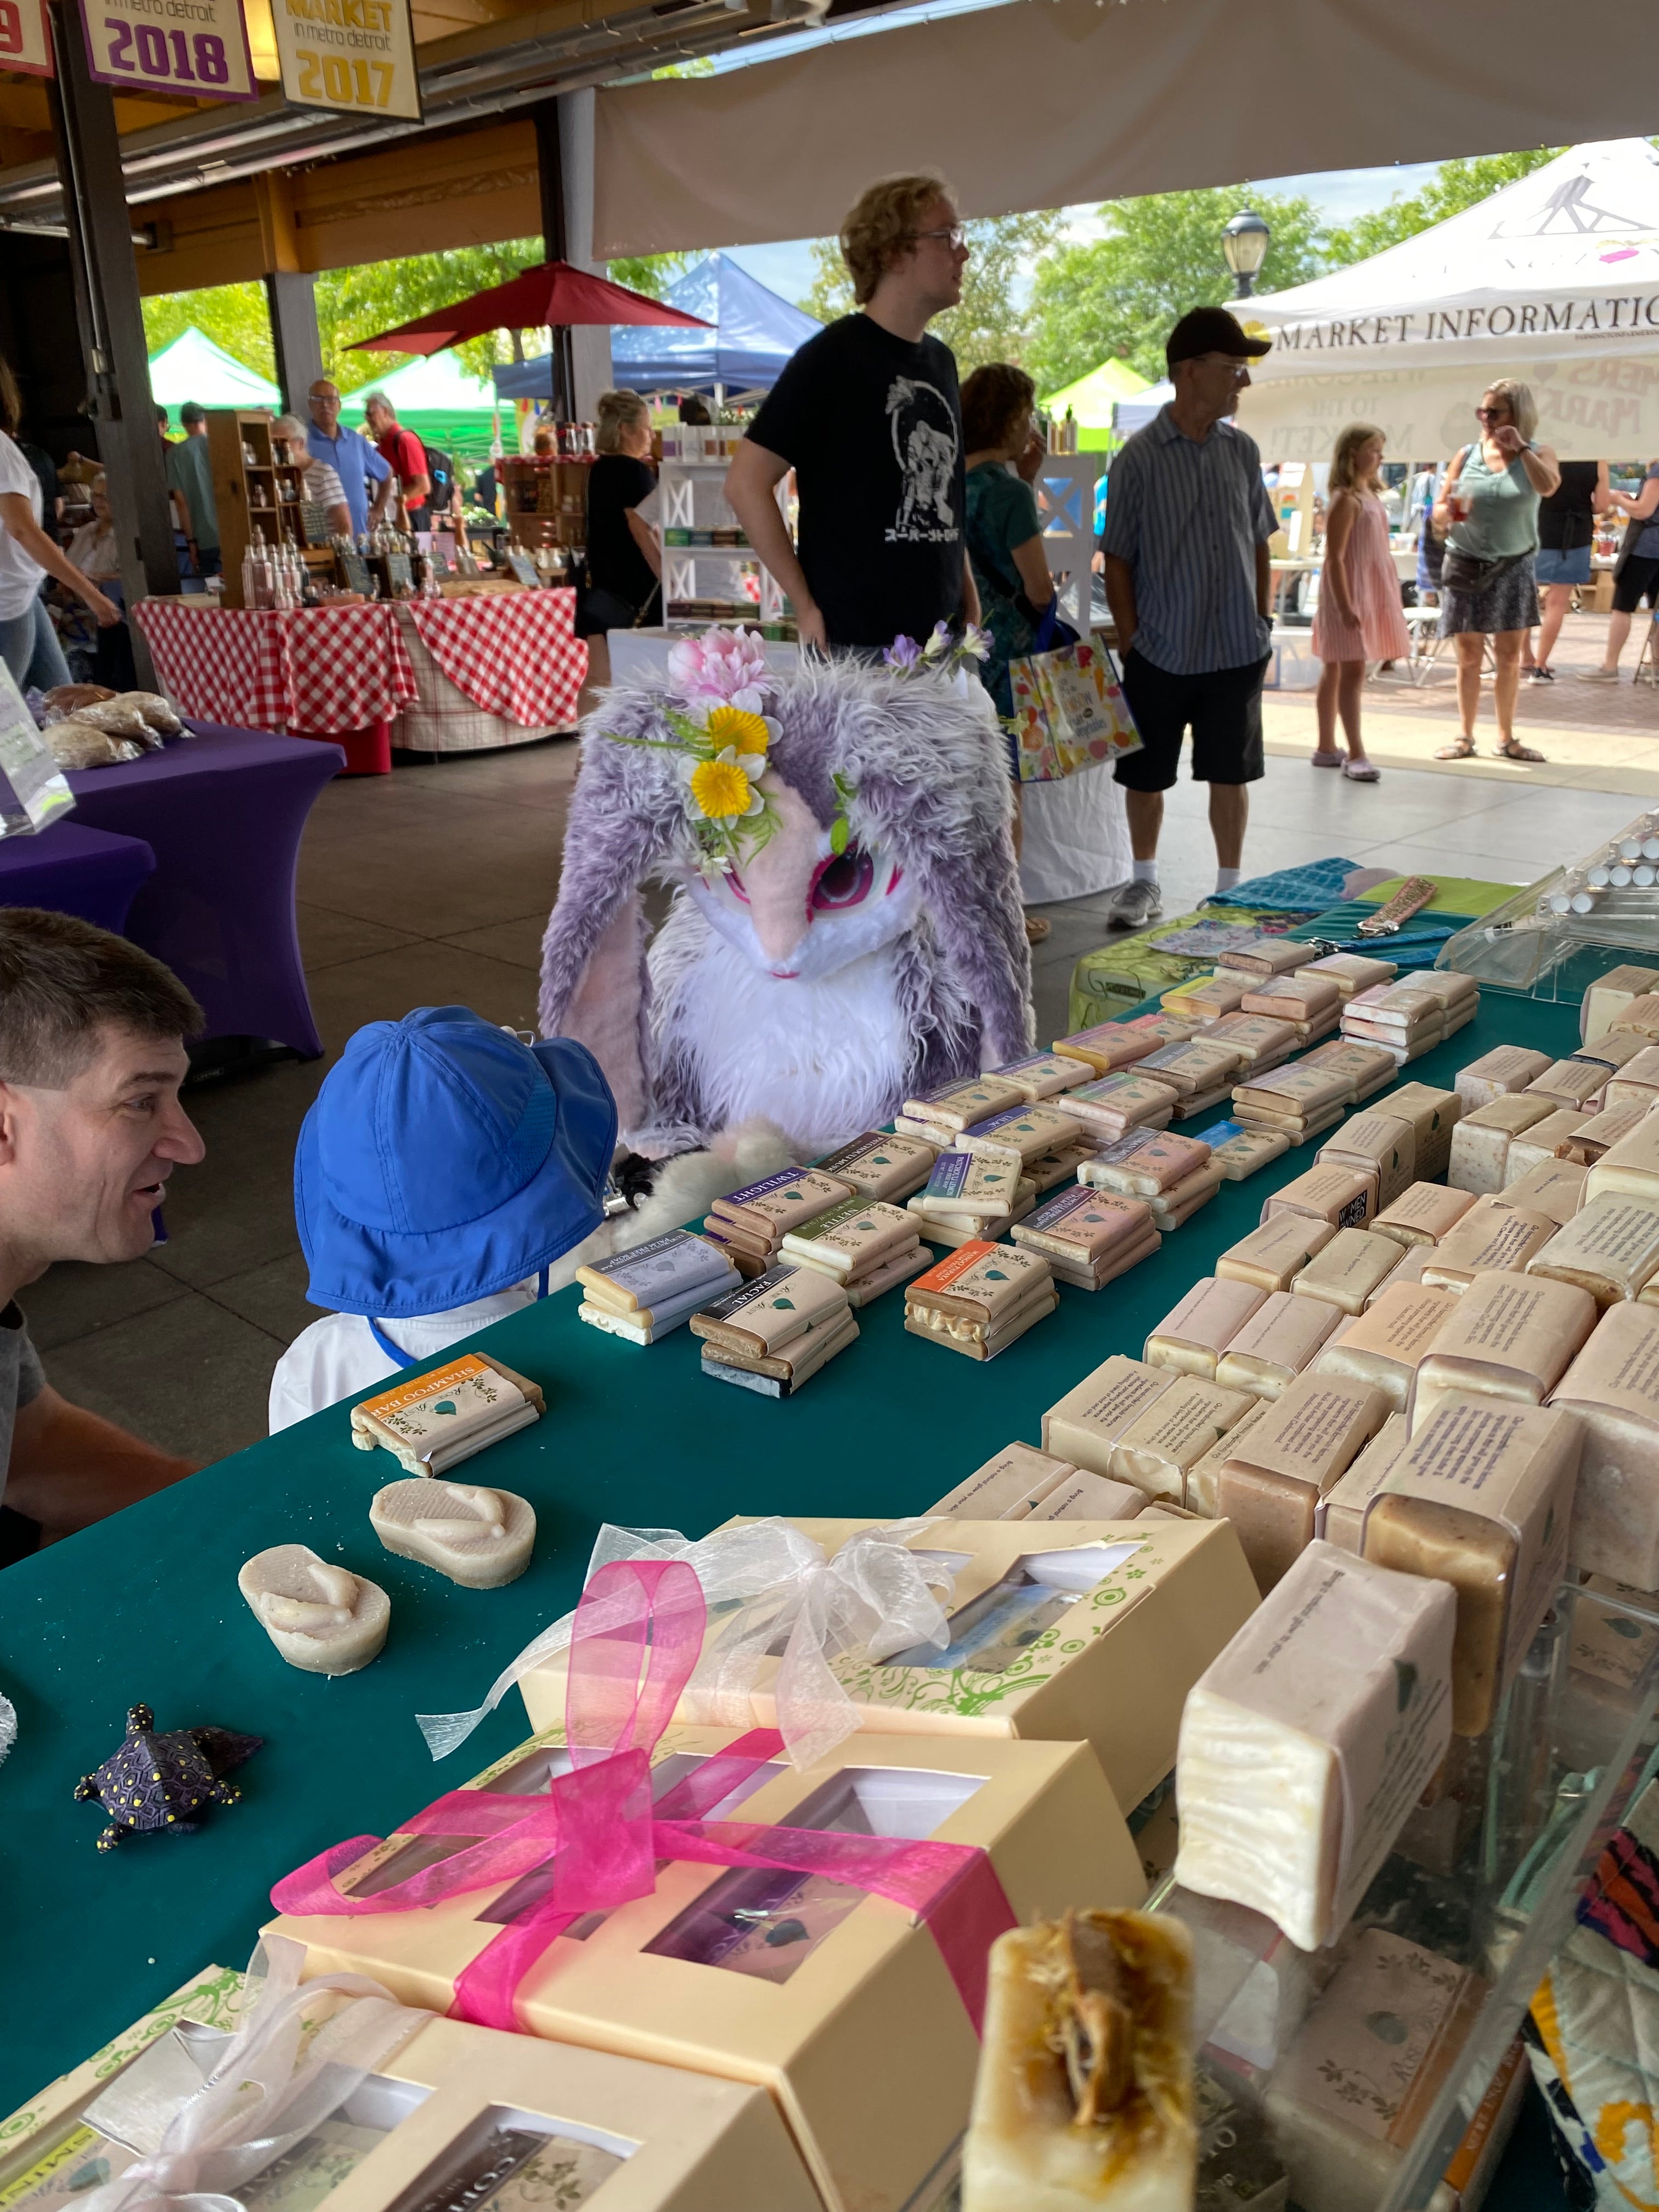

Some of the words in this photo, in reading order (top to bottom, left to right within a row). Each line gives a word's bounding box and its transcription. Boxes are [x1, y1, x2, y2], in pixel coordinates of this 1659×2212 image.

[166, 1, 216, 22] detroit
[285, 0, 392, 32] MARKET
[294, 22, 305, 38] in
[306, 25, 345, 46] metro
[347, 29, 392, 51] detroit
[104, 17, 229, 83] 2018
[296, 49, 394, 108] 2017
[1276, 314, 1414, 352] MARKET
[987, 1114, 1012, 1130] LILAC
[846, 1136, 884, 1159] PATCHOULI
[826, 1158, 849, 1172] MUSK
[951, 1156, 963, 1180] PATCHOULI
[731, 1171, 799, 1200] TWILIGHT
[946, 1181, 957, 1195] LEMON
[1058, 1187, 1089, 1210] PATCHOULI
[818, 1207, 858, 1228] NETTLE
[1033, 1208, 1062, 1228] BERGAMOT
[956, 1250, 979, 1266] MANGO
[938, 1265, 961, 1281] PAPAYA
[730, 1280, 773, 1305] FACIAL
[769, 1283, 799, 1300] ROSE
[744, 1299, 774, 1315] BEST
[404, 1366, 475, 1401] SHAMPOO
[438, 1384, 473, 1401] ROSE
[1131, 1387, 1152, 1404] handcrafted
[371, 1399, 401, 1417] BAR
[403, 1399, 440, 1417] BEST
[1118, 1403, 1134, 1416] formula
[1212, 1402, 1222, 1410] Our
[1353, 1401, 1364, 1409] Our
[1104, 1414, 1122, 1427] features
[1195, 1409, 1216, 1427] handcrafted
[1183, 1427, 1199, 1441] formula
[1170, 1440, 1187, 1453] features
[1211, 1449, 1221, 1460] Our
[998, 1459, 1013, 1471] Bring
[981, 1472, 998, 1485] natural
[970, 1482, 985, 1493] glow
[1069, 1488, 1084, 1500] Bring
[956, 1495, 968, 1505] your
[1052, 1502, 1070, 1517] natural
